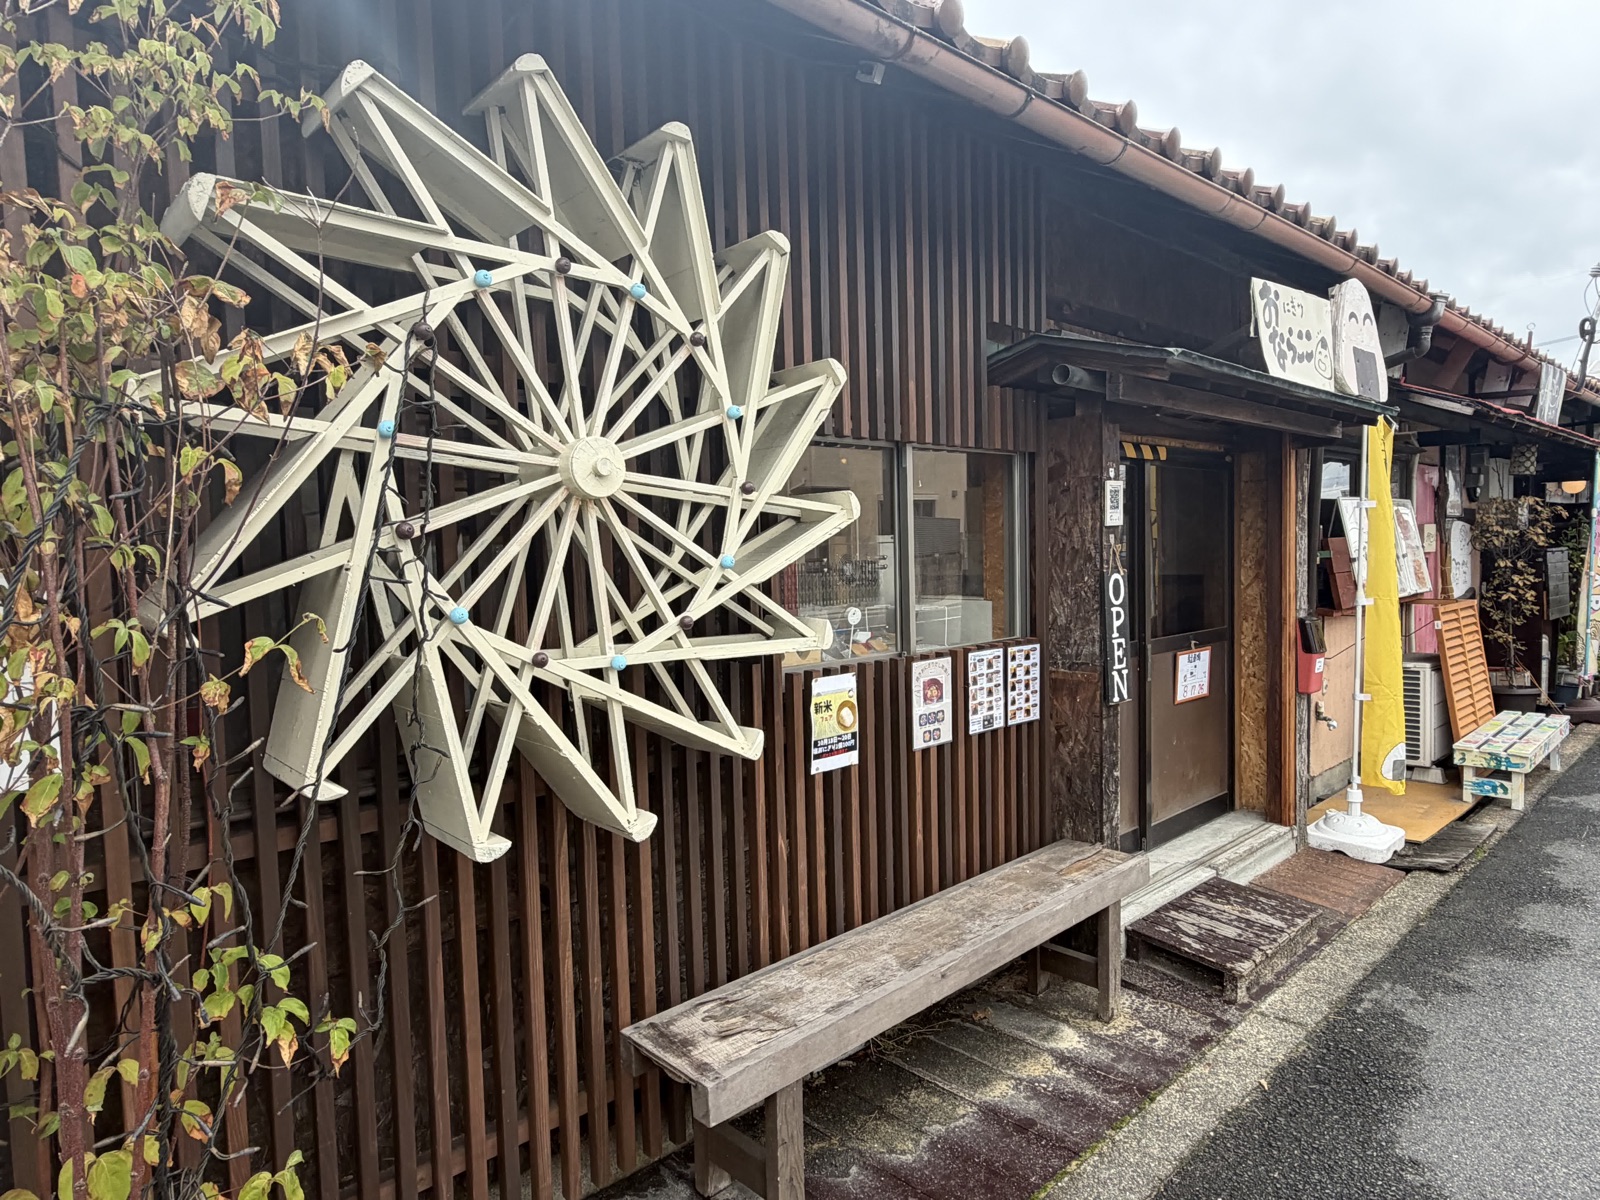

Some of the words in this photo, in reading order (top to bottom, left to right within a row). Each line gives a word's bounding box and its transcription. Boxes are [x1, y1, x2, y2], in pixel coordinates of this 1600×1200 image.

[1108, 573, 1129, 703] OPEN
[814, 699, 833, 715] 新米
[820, 714, 833, 722] フェア
